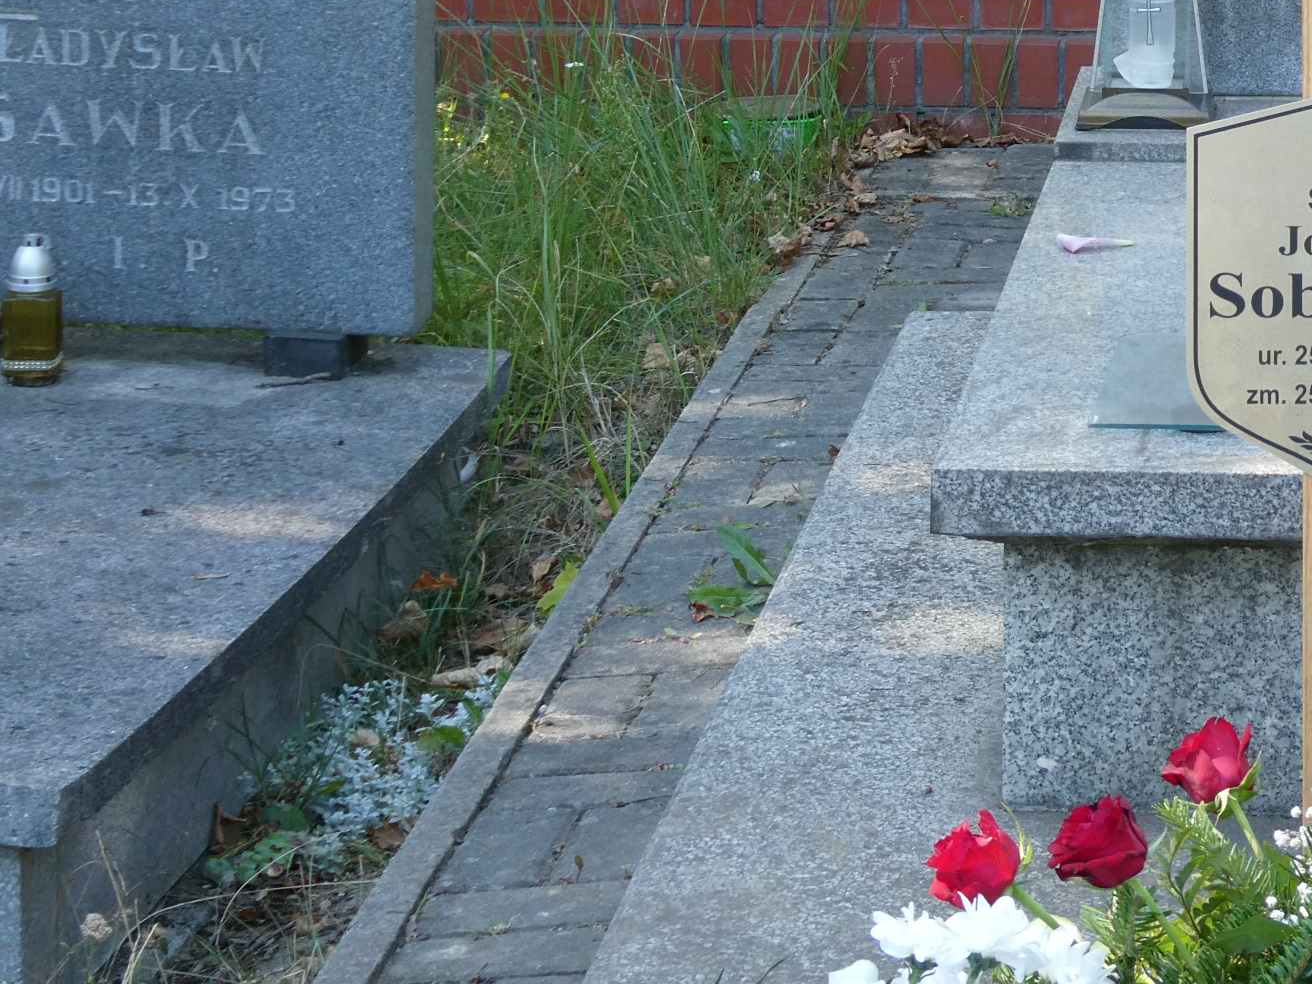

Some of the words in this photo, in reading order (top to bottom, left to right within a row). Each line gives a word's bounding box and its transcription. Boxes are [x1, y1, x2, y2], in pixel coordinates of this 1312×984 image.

[217, 187, 297, 213] 1973
[1258, 349, 1287, 366] ur.
[1246, 388, 1287, 405] zm.
